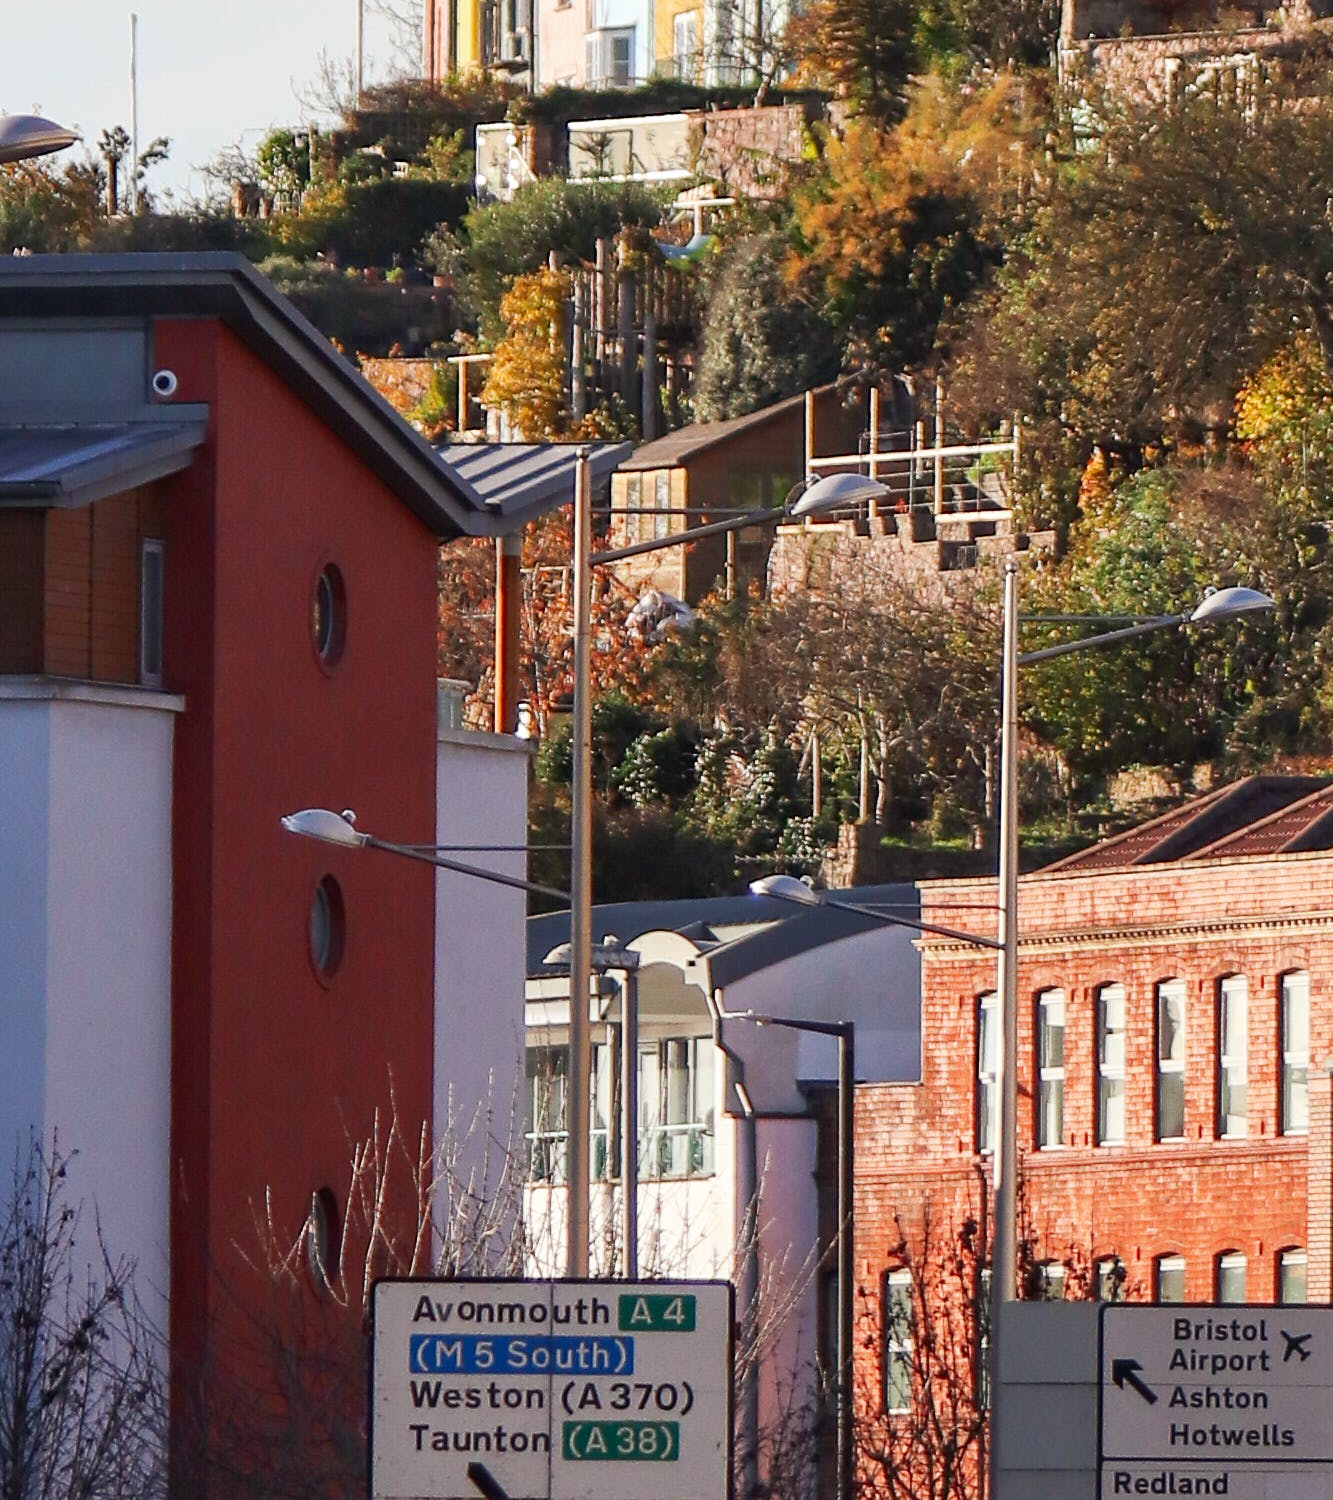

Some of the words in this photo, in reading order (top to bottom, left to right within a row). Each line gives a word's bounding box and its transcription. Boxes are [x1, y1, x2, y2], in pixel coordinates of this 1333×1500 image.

[412, 1295, 610, 1324] Avonmouth
[1173, 1318, 1269, 1342] Bristol
[507, 1338, 629, 1372] South)
[1169, 1348, 1270, 1375] Airport
[409, 1381, 545, 1409] Weston
[1168, 1386, 1269, 1410] Ashton
[409, 1424, 551, 1453] Taunton
[1169, 1423, 1295, 1447] Hotwells
[1114, 1471, 1229, 1495] Redland
